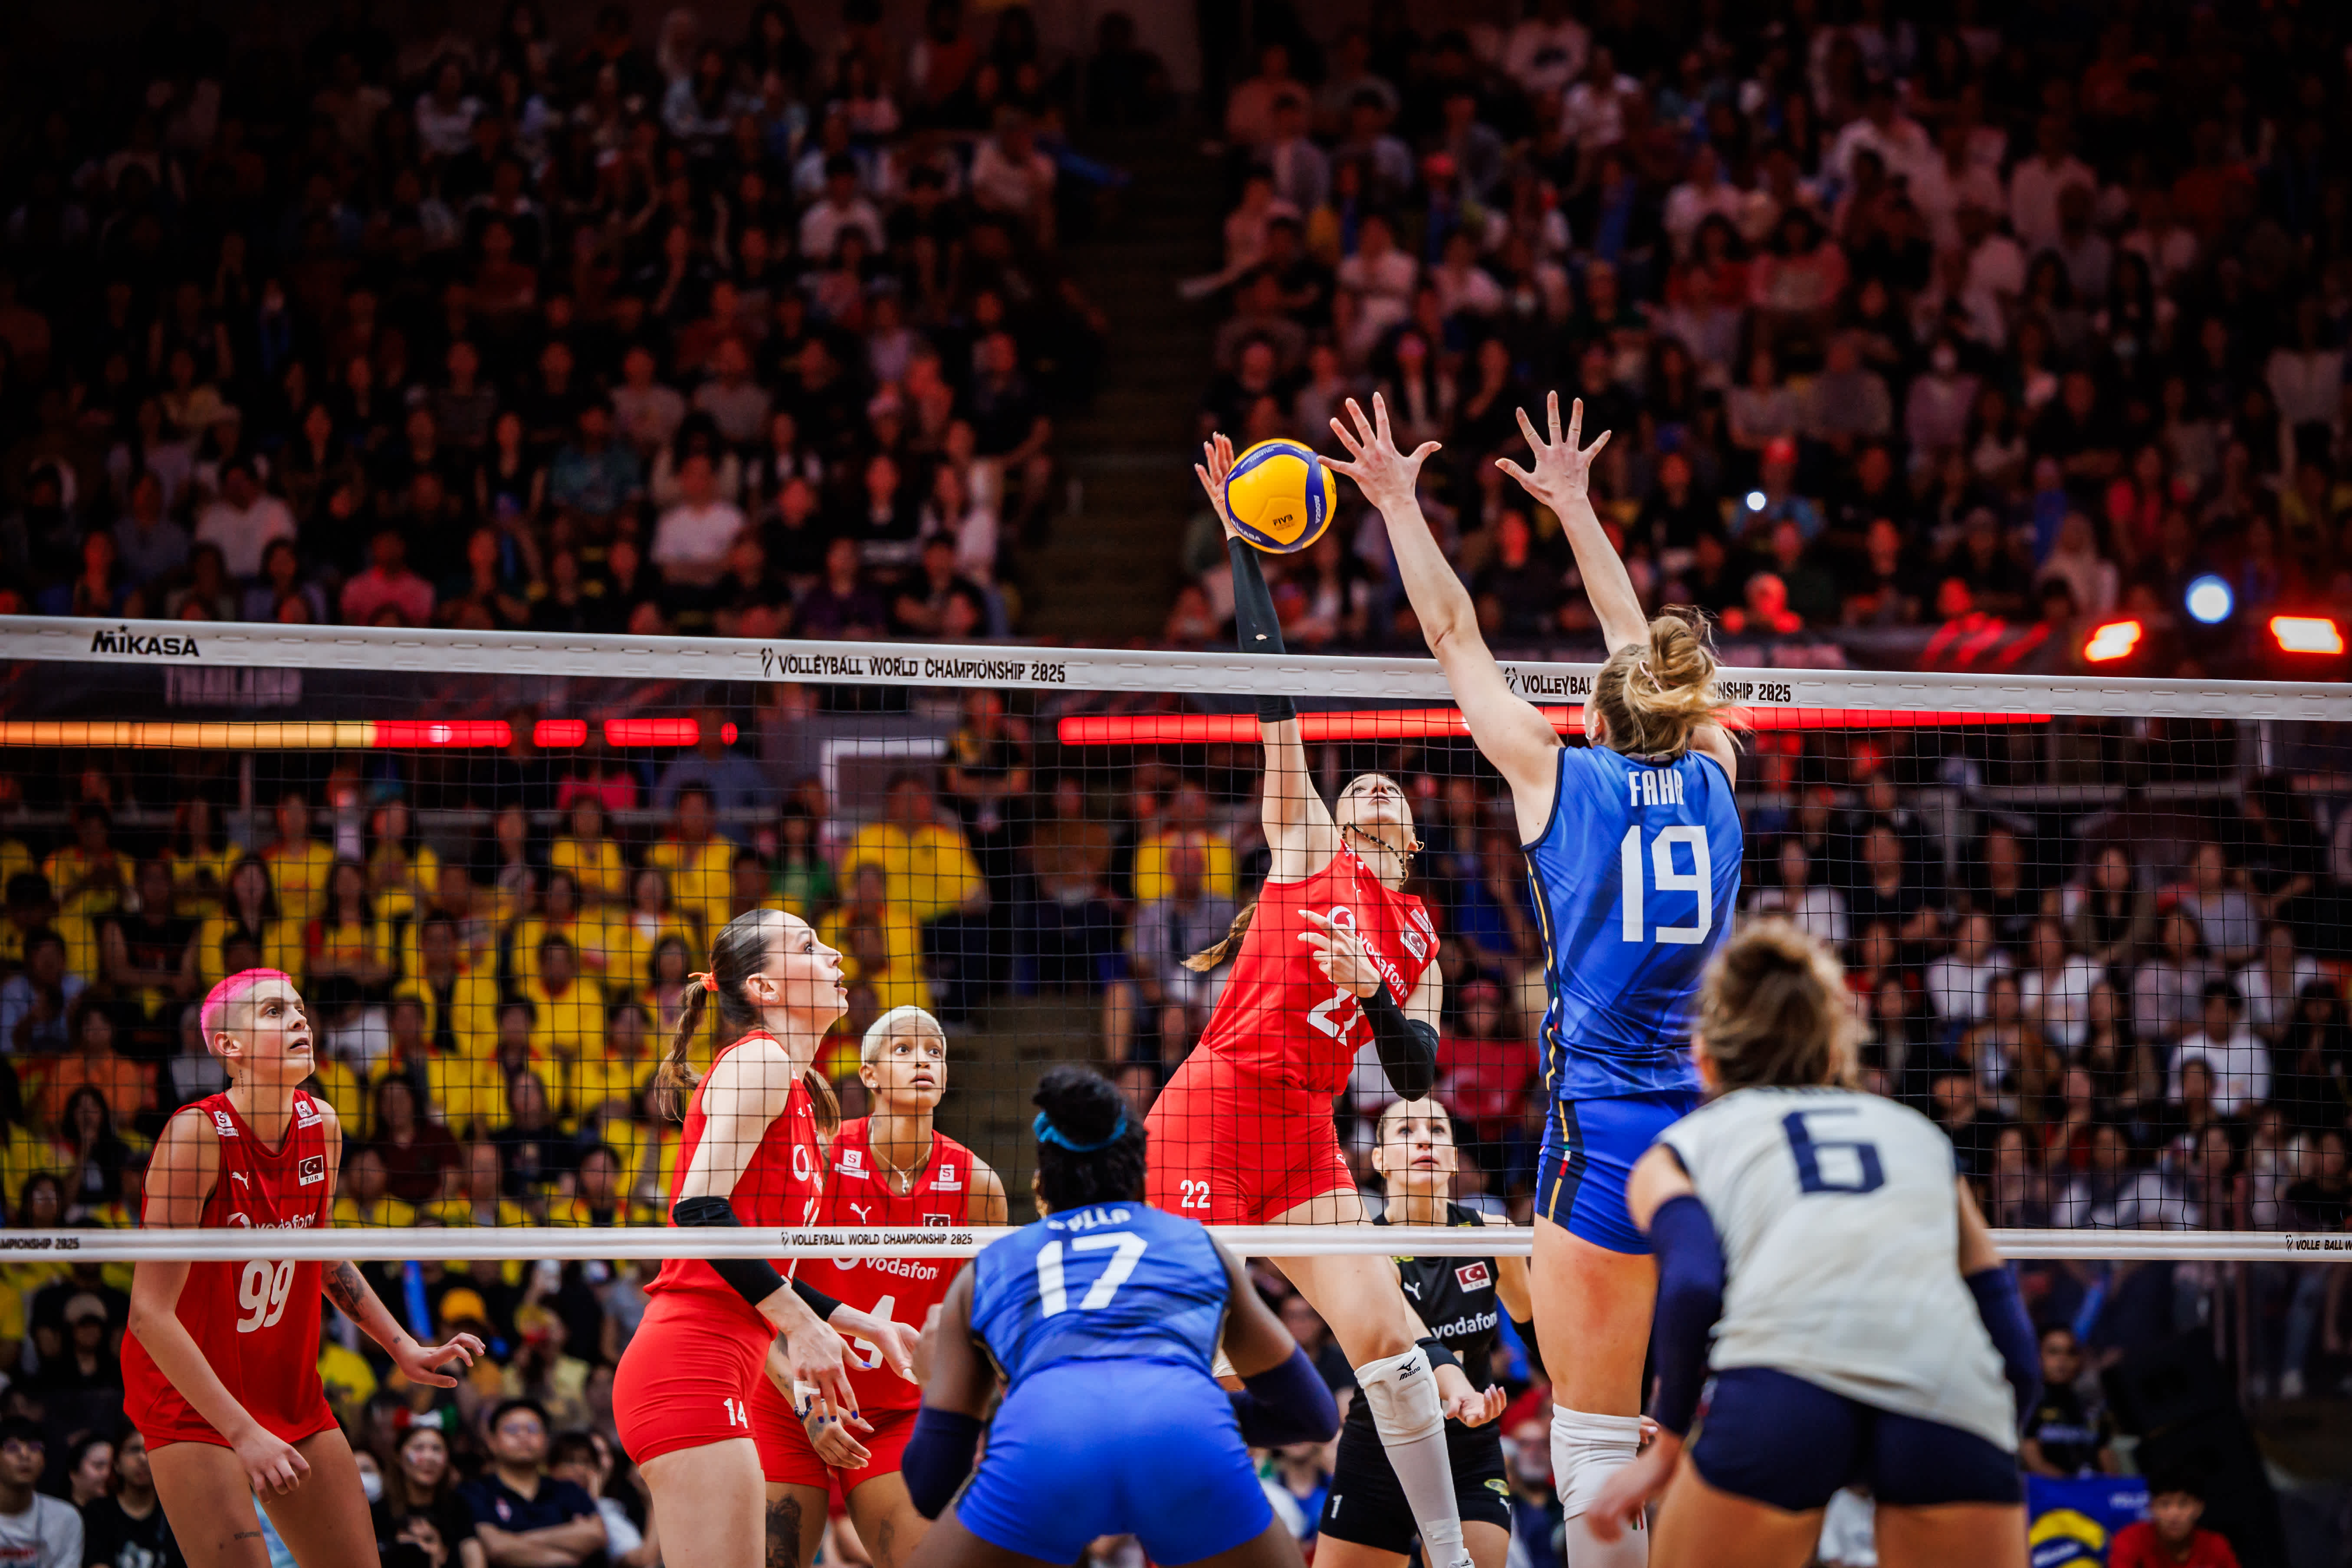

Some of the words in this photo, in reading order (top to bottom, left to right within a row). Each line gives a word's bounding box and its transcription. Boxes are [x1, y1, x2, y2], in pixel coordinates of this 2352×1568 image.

[779, 653, 864, 676] VOLLEYBALL
[869, 656, 918, 677] WORLD
[925, 657, 1026, 680] CHAMPIONSHIP
[1031, 664, 1065, 683] 2025
[1521, 675, 1593, 696] VOLLEYBAL
[1759, 684, 1791, 703] 2025
[1629, 768, 1684, 806] FAHR
[1621, 825, 1712, 944] 19
[219, 1114, 227, 1123] S
[848, 1154, 857, 1163] S
[1782, 1107, 1885, 1193] 6
[305, 1174, 319, 1183] TUR
[943, 1167, 951, 1177] S
[1180, 1180, 1211, 1209] 22
[55, 1237, 80, 1249] 2025
[792, 1234, 844, 1245] VOLLEYBALL
[849, 1234, 879, 1245] WORLD
[884, 1234, 947, 1245] CHAMPIONSHIP
[951, 1234, 973, 1245] 2025
[866, 1256, 939, 1280] vodafon
[1037, 1231, 1148, 1318] 17
[236, 1259, 296, 1333] 99
[1431, 1311, 1498, 1339] vodafon
[723, 1398, 749, 1429] 14
[1331, 1494, 1343, 1519] 1
